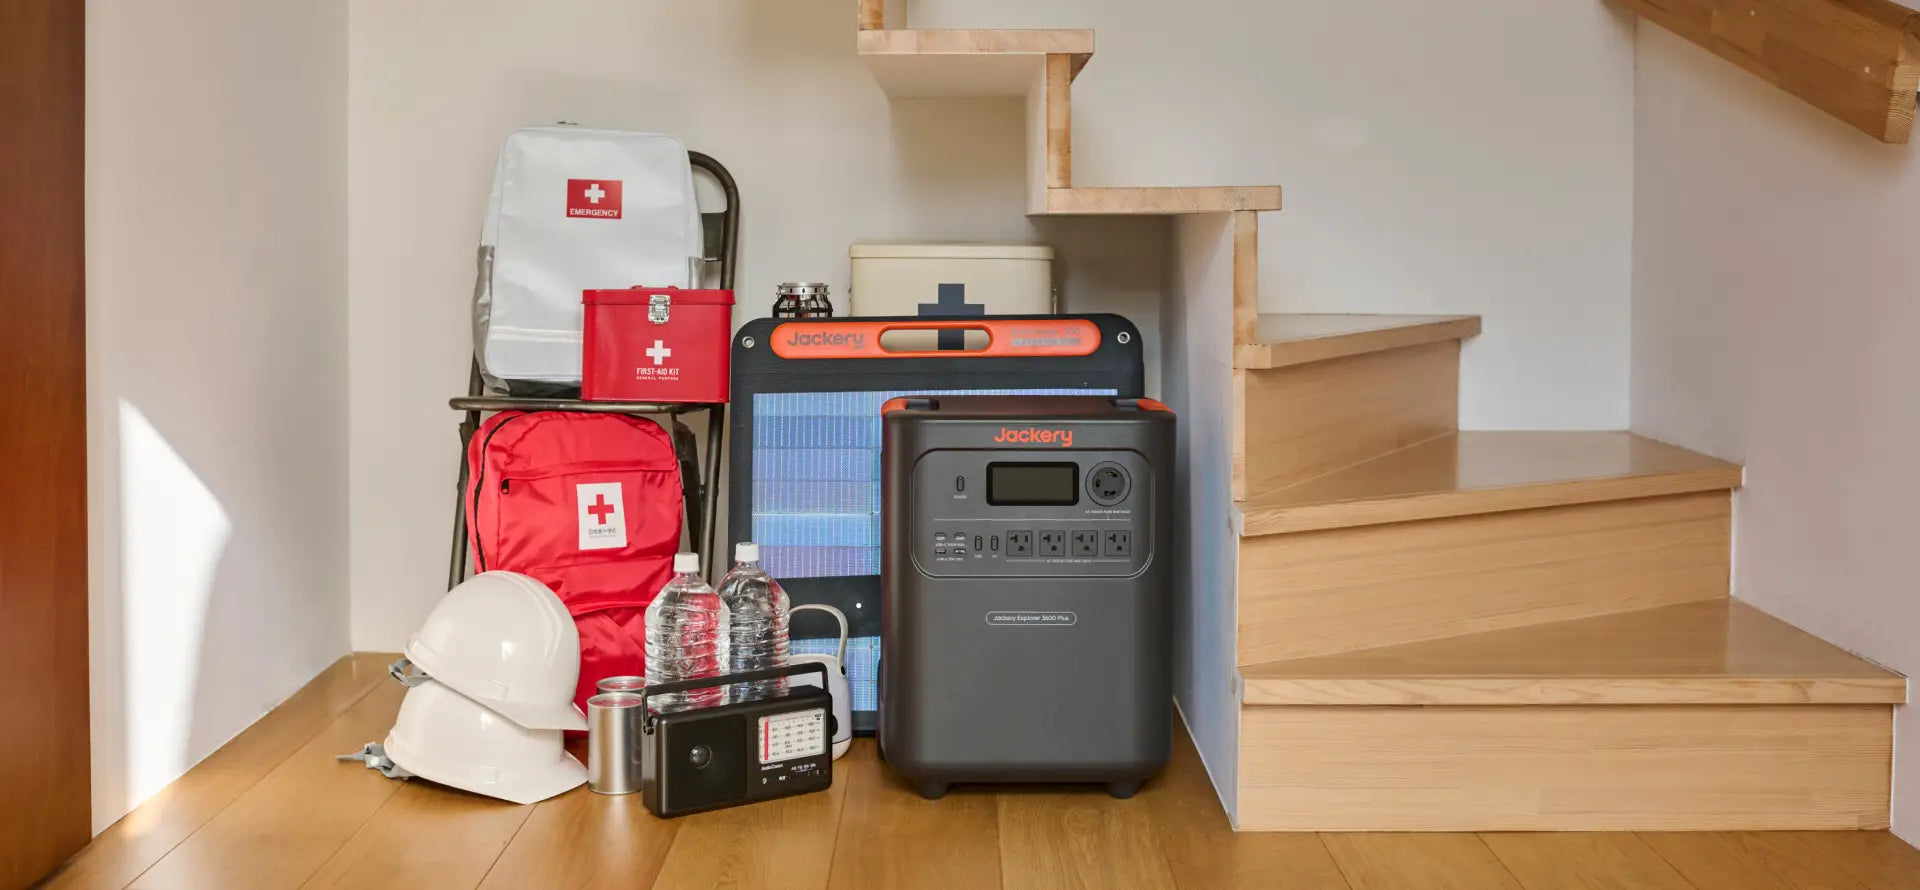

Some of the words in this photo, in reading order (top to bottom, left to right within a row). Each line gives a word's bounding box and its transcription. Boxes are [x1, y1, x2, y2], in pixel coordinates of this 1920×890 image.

[570, 208, 619, 217] EMERGENCY
[787, 331, 864, 350] Jackery
[636, 367, 668, 376] FIRST-AID
[669, 368, 680, 376] KIT
[994, 427, 1073, 448] Jackery
[993, 614, 1016, 622] Jackery
[1017, 614, 1040, 623] Explorer
